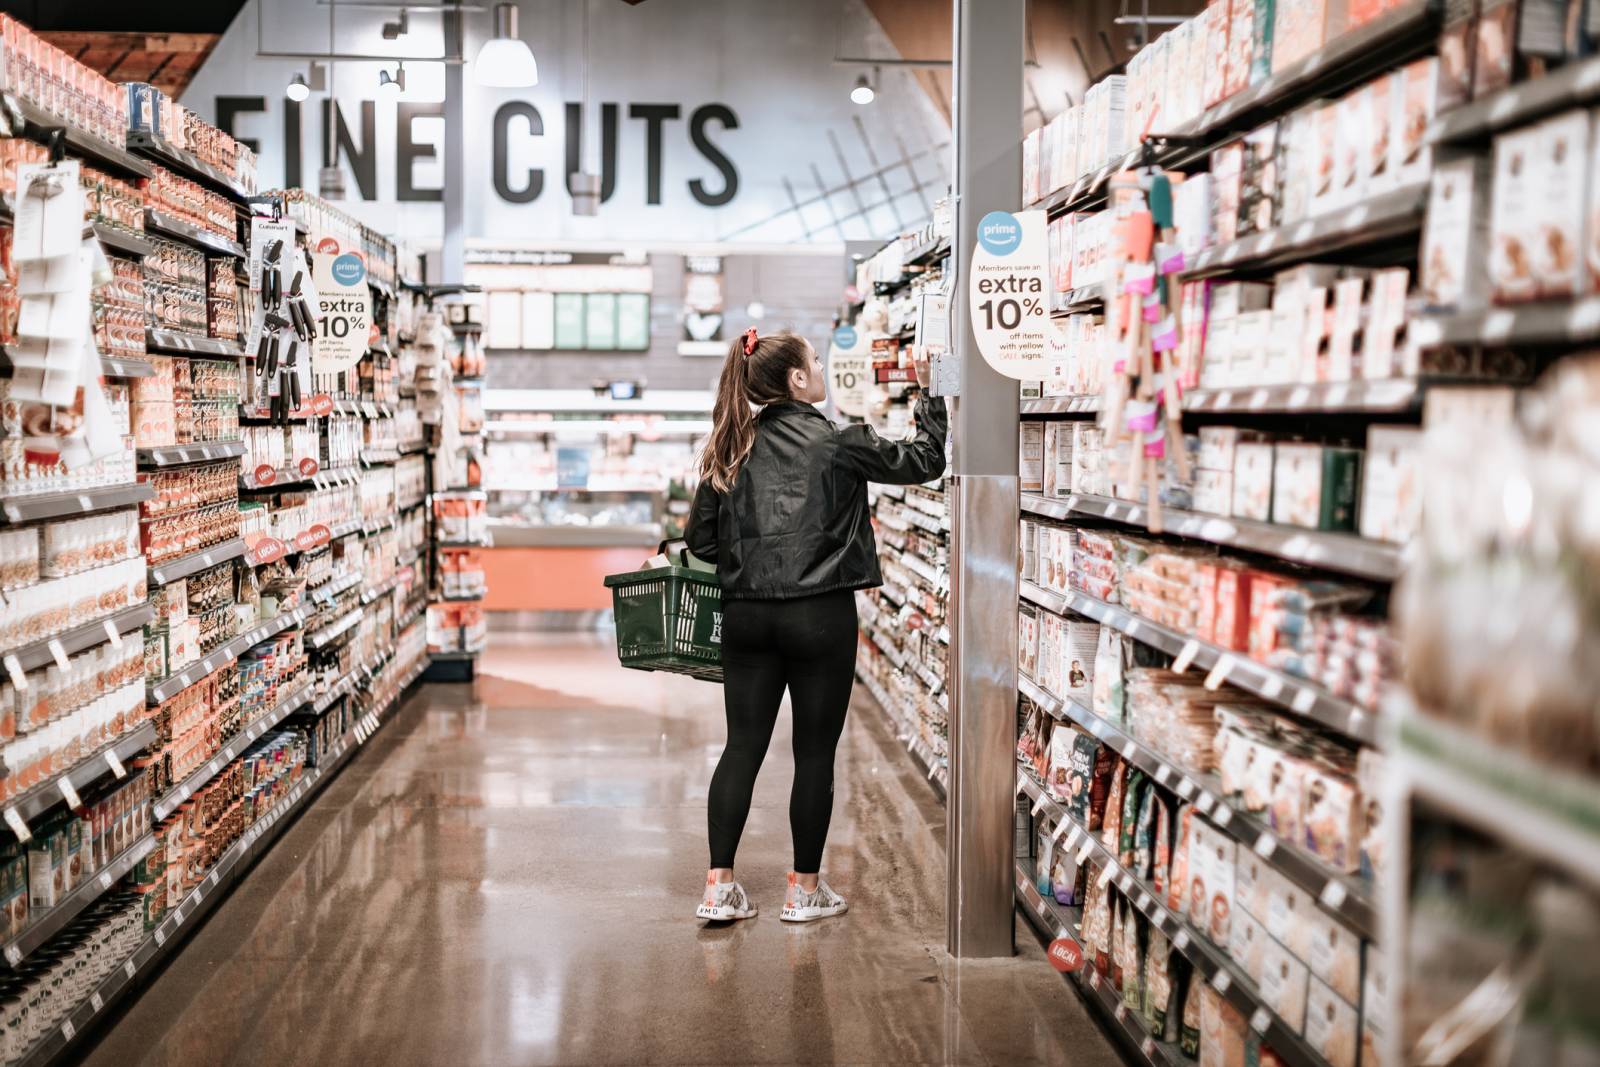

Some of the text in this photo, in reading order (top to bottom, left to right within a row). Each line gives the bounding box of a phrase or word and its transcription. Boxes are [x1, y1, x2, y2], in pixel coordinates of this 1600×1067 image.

[215, 96, 741, 206] FINE CUTS
[983, 224, 1017, 237] prime
[336, 261, 360, 272] prime
[978, 274, 1042, 294] extra
[319, 299, 364, 312] extra
[978, 298, 1043, 330] 10%
[318, 316, 365, 338] 10%
[1000, 342, 1043, 351] with yellow
[888, 371, 908, 380] LOCAL
[258, 541, 278, 559] LOCAL
[1052, 944, 1077, 965] LOCAL
